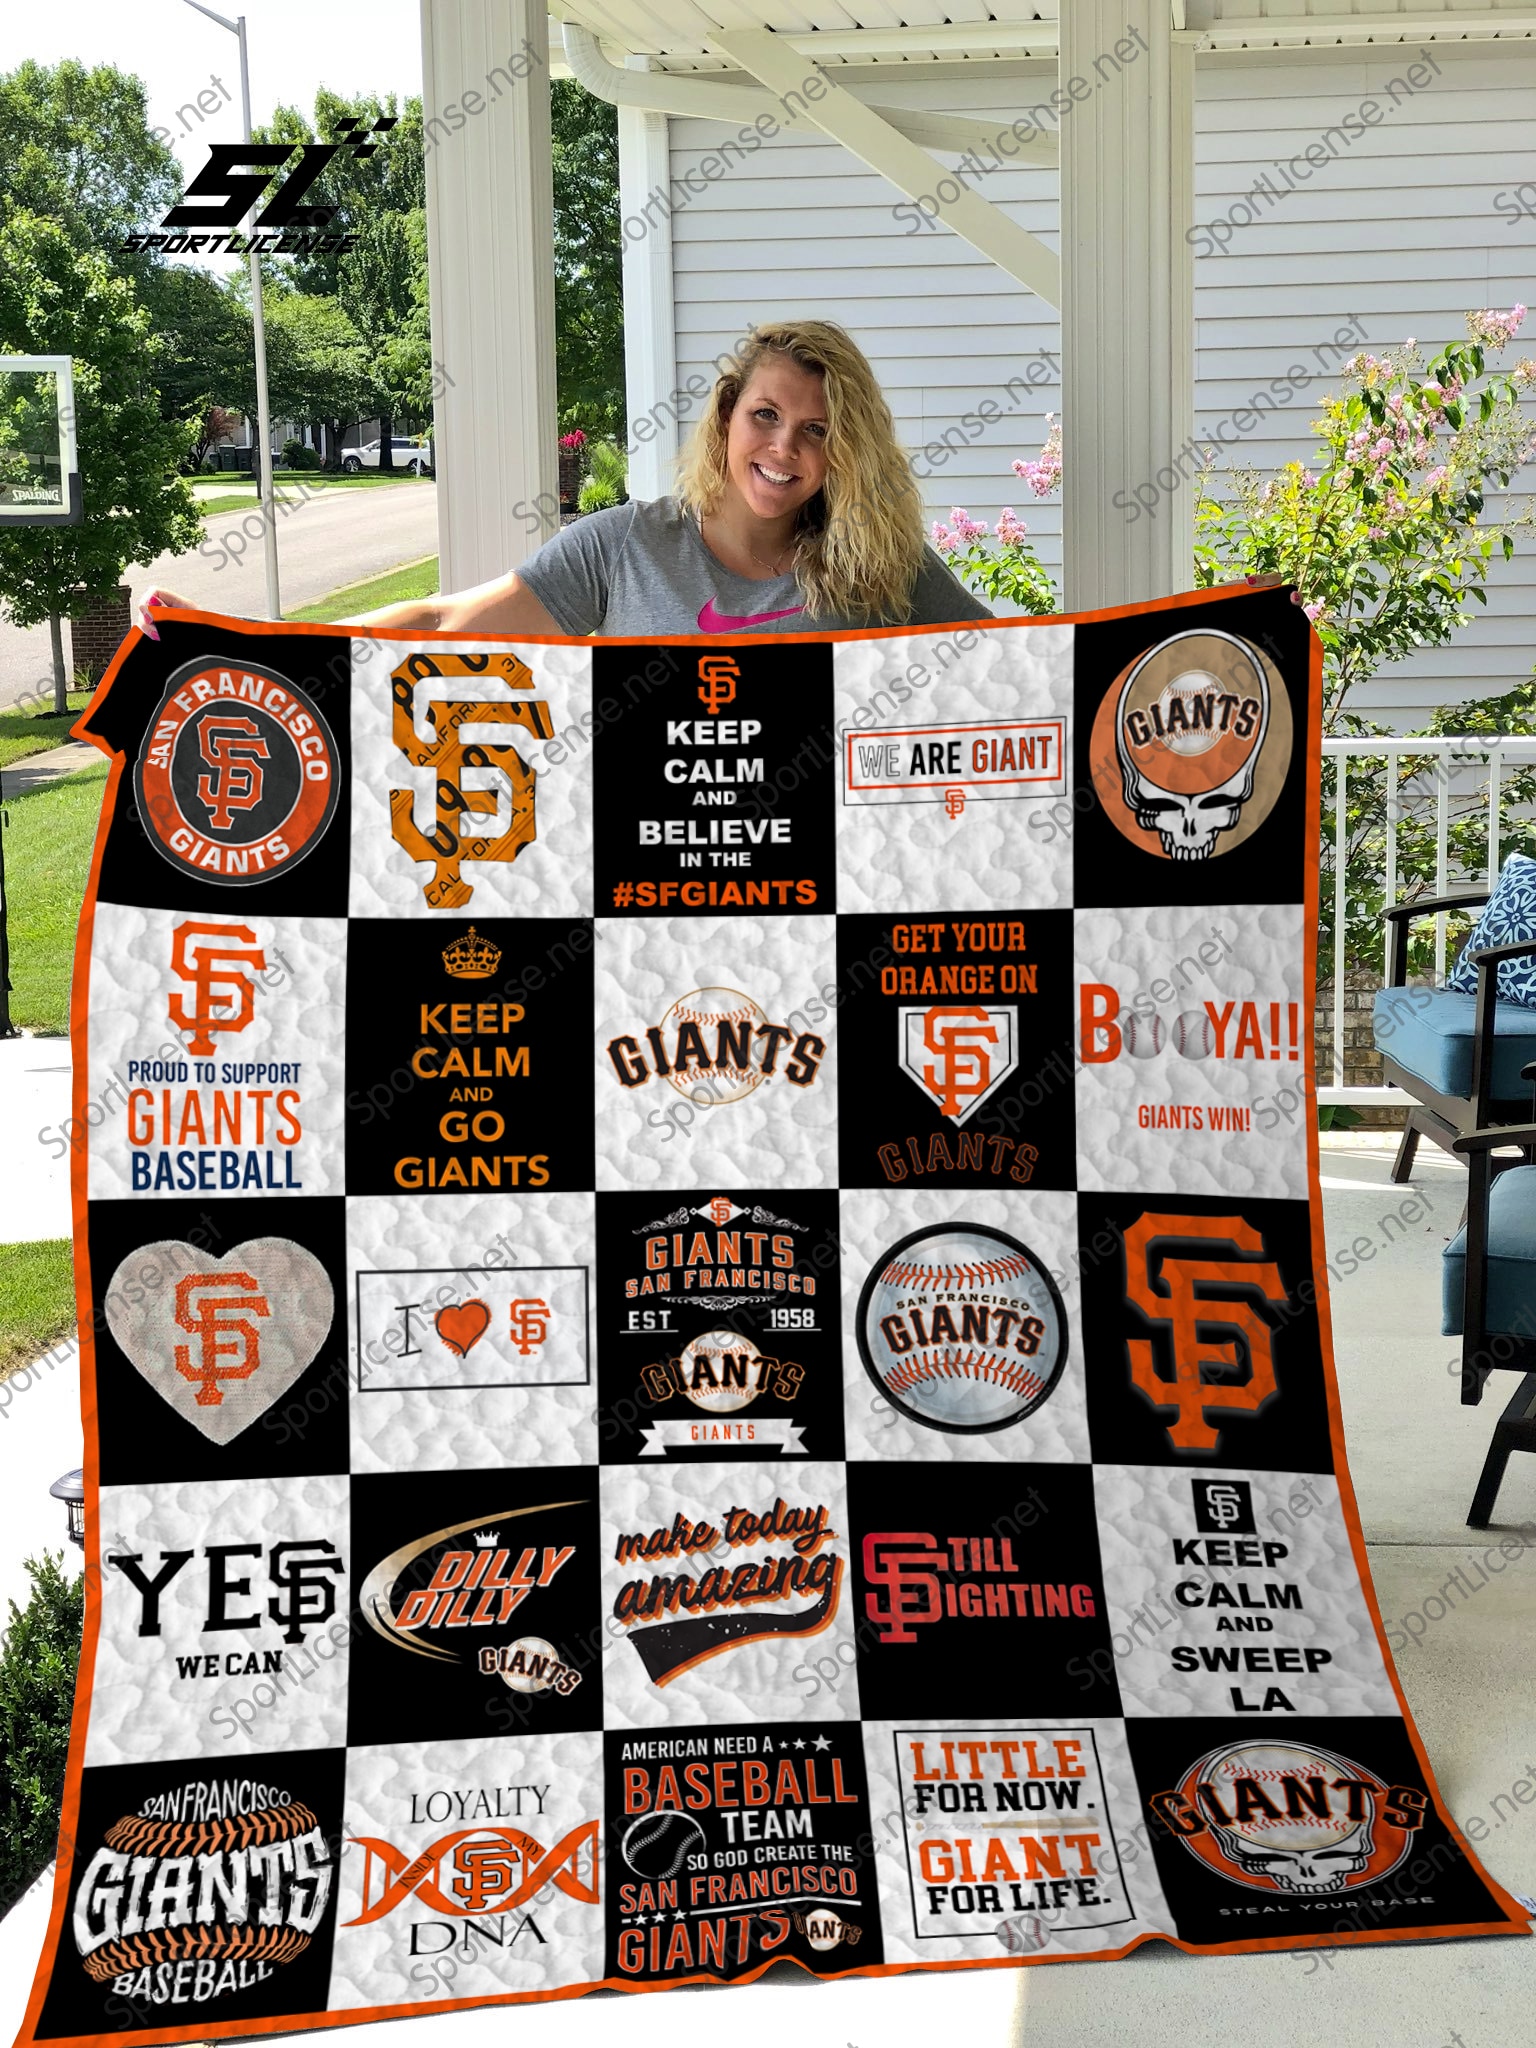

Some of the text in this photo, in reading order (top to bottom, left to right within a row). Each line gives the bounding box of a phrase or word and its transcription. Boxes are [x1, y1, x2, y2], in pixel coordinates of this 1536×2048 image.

[12, 489, 60, 502] SPALDING
[146, 672, 329, 782] SAN FRANCISCO
[667, 720, 762, 745] KEEP
[1124, 693, 1263, 749] GIANTS
[664, 758, 764, 784] CALM
[858, 735, 1053, 779] WE ARE GIANT
[692, 790, 738, 806] AND
[639, 818, 792, 845] BELIEVE
[169, 826, 290, 874] GIANTS
[680, 852, 752, 868] IN THE
[613, 879, 817, 908] #SFGIANTS
[892, 921, 1026, 953] GET YOUR
[881, 964, 1038, 995] ORANGE ON
[420, 1003, 525, 1035] KEEP
[411, 1047, 530, 1079] CALM
[606, 1020, 827, 1089] GIANTS
[128, 1060, 302, 1084] PROUD TO SUPPORT
[449, 1087, 493, 1102] AND
[127, 1088, 302, 1146] GIANTS
[439, 1110, 505, 1143] GO
[1138, 1104, 1251, 1132] GIANTS WIN!
[131, 1150, 303, 1191] BASEBALL
[393, 1154, 550, 1189] GIANTS
[877, 1132, 1039, 1183] GIANTS
[646, 1231, 794, 1270] GIANTS
[625, 1269, 816, 1298] SAN FRANCISCO
[770, 1308, 815, 1328] 1958
[896, 1293, 1030, 1311] SAN FRANCISCO
[394, 1303, 423, 1358] I
[628, 1310, 671, 1330] EST
[879, 1304, 1046, 1357] GIANTS
[640, 1353, 805, 1402] GIANTS
[691, 1424, 755, 1441] GIANTS
[615, 1497, 839, 1565] make today
[427, 1546, 576, 1591] DILLY
[1172, 1538, 1289, 1568] KEEP
[613, 1553, 845, 1628] amazing
[1175, 1581, 1304, 1610] CALM
[394, 1588, 531, 1631] DILLY
[1216, 1616, 1274, 1632] AND
[176, 1650, 283, 1679] WE CAN
[478, 1647, 582, 1695] GIANTS
[1170, 1646, 1333, 1673] SWEEP
[1229, 1686, 1297, 1712] LA
[621, 1736, 774, 1761] AMERICAN NEED A
[910, 1739, 1087, 1781] LITTLE
[623, 1758, 859, 1815] BASEBALL
[914, 1780, 1096, 1814] FOR NOW.
[410, 1784, 552, 1825] LOYALTY
[1149, 1775, 1429, 1839] GIANTS
[720, 1808, 814, 1844] TEAM
[517, 1835, 540, 1858] MY
[687, 1844, 854, 1871] SO GOD CREATE THE
[918, 1833, 1102, 1884] GIANT
[398, 1851, 439, 1889] INSIDE
[72, 1825, 334, 1957] GIANTS
[619, 1865, 858, 1914] SAN FRANCISCO
[927, 1878, 1112, 1915] FOR LIFE.
[1218, 1896, 1436, 1917] STEAL YOUR BASE
[408, 1913, 548, 1957] DNA
[617, 1909, 791, 1974] GIANTS
[111, 1958, 274, 2005] BASEBALL
